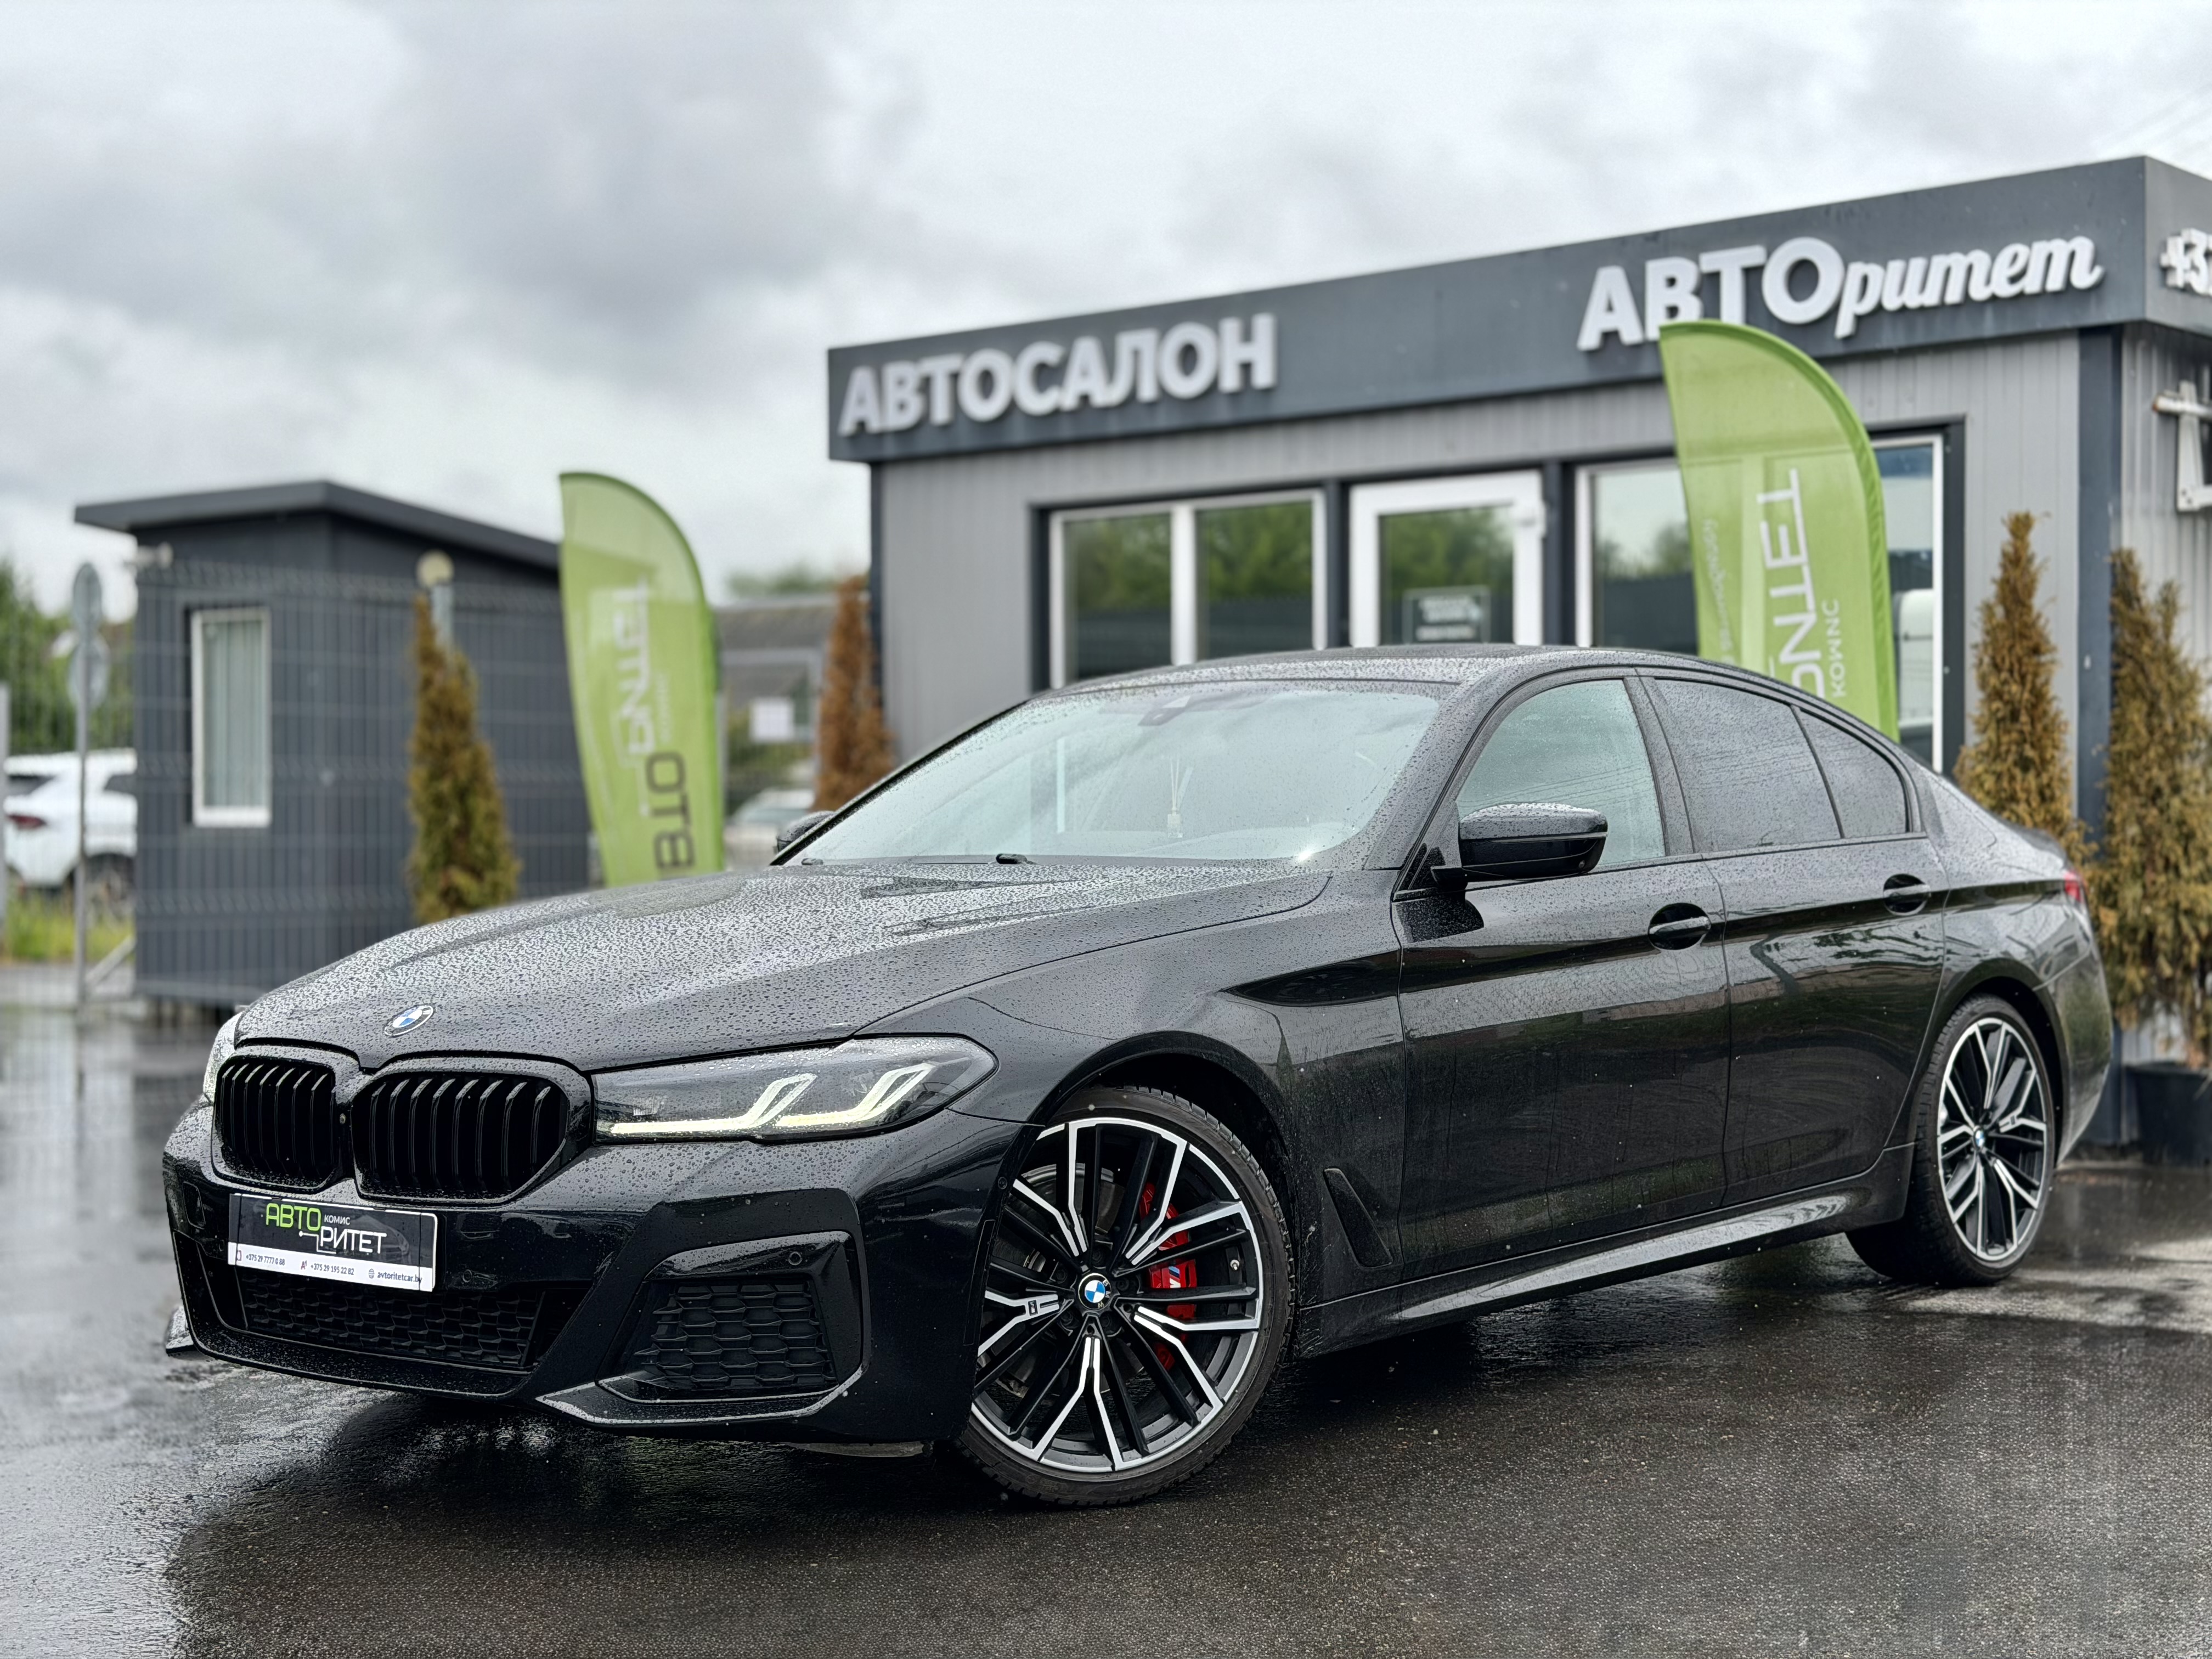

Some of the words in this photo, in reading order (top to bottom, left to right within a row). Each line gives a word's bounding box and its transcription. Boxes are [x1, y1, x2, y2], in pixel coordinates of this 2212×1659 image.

[839, 313, 1276, 436] АВТОСАЛОН
[266, 1203, 321, 1231] АВТО
[324, 1214, 351, 1226] КОМИС
[320, 1226, 387, 1254] РИТЕТ
[246, 1254, 257, 1262] +375
[311, 1263, 323, 1271] +375
[348, 1267, 354, 1276] 82
[377, 1271, 422, 1283] avtoritetcar.by
